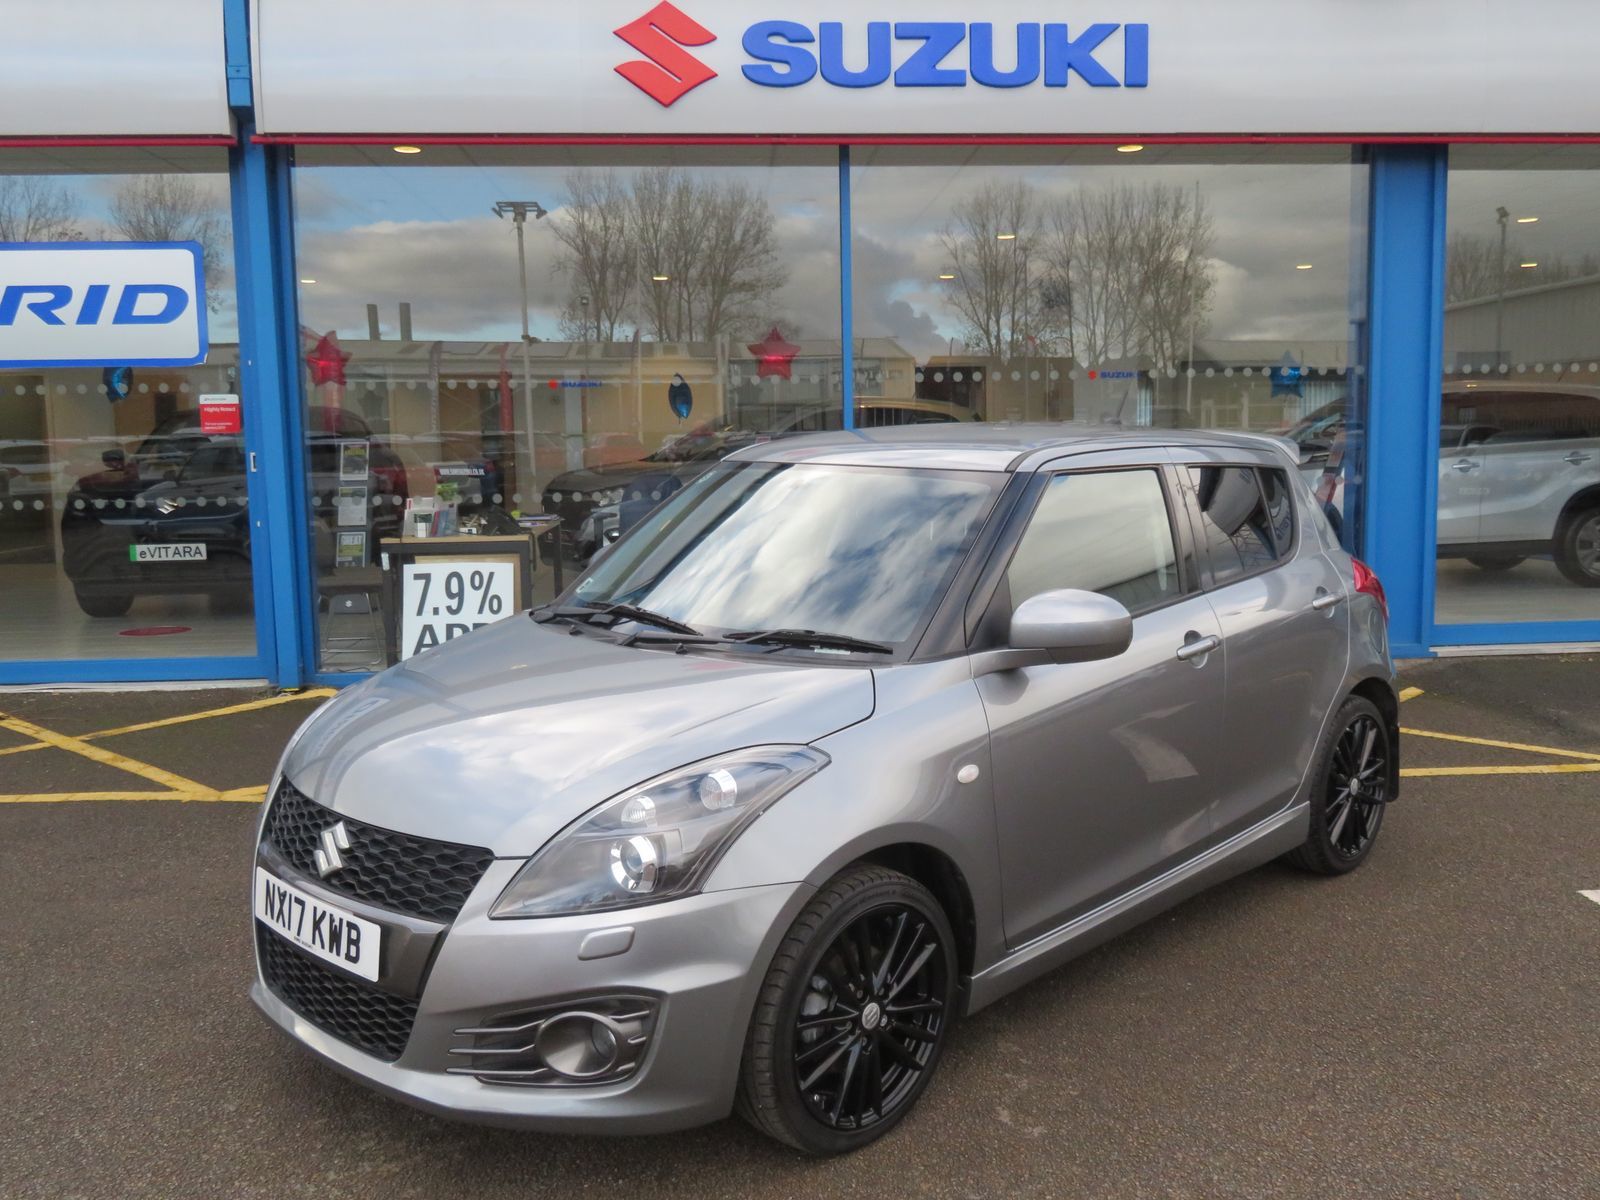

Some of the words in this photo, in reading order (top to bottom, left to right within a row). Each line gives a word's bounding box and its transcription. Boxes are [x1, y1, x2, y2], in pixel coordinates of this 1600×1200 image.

[741, 20, 1149, 89] SUZUKI
[0, 284, 189, 326] RID
[139, 546, 203, 559] eVITARA
[413, 570, 503, 617] 7.9%
[264, 879, 306, 937] NX17
[311, 906, 361, 965] KWB
